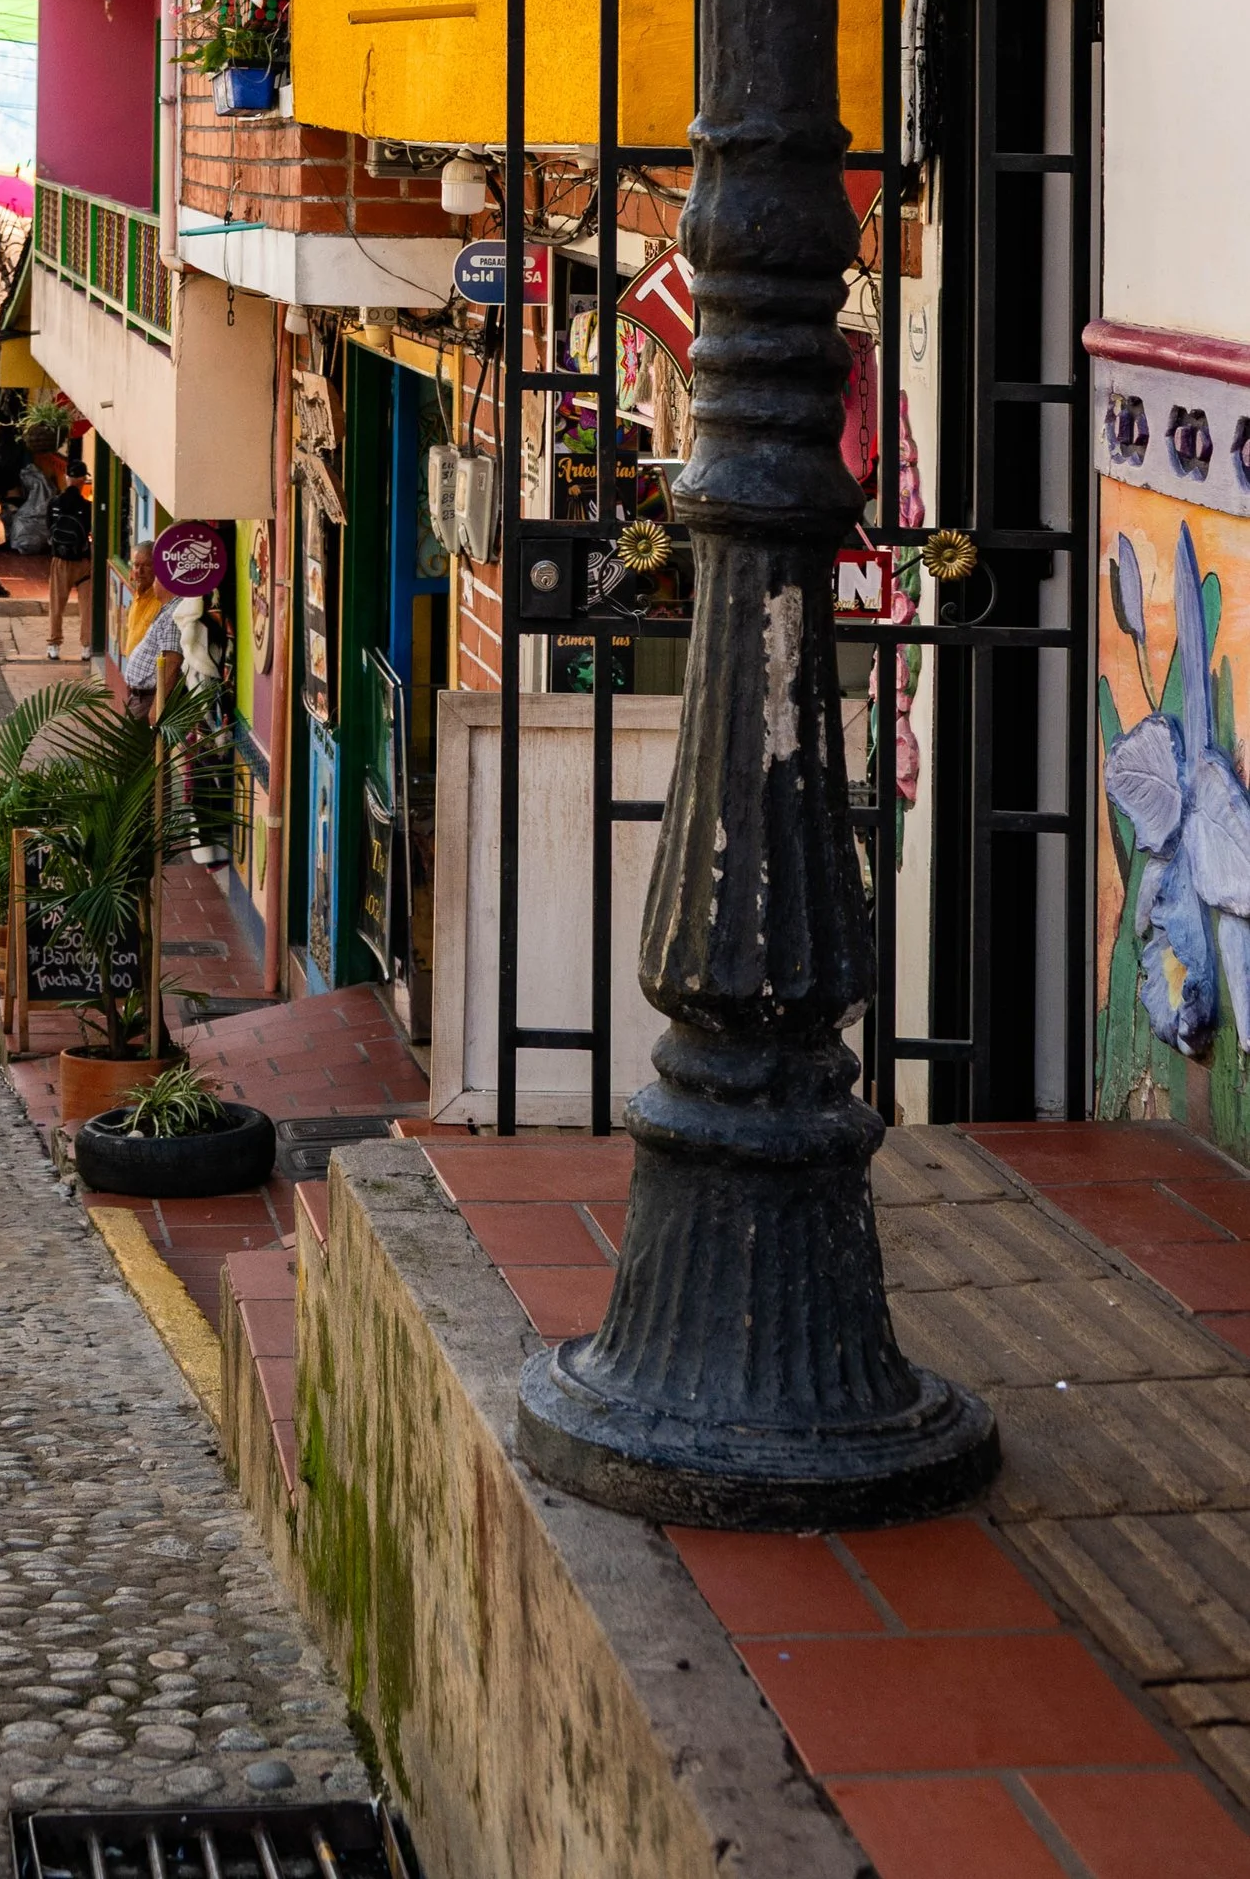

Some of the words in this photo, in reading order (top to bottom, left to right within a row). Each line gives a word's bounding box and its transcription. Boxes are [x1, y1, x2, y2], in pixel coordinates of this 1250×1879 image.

[462, 270, 494, 282] bold
[162, 550, 196, 562] Dulce
[177, 561, 220, 572] Capricho
